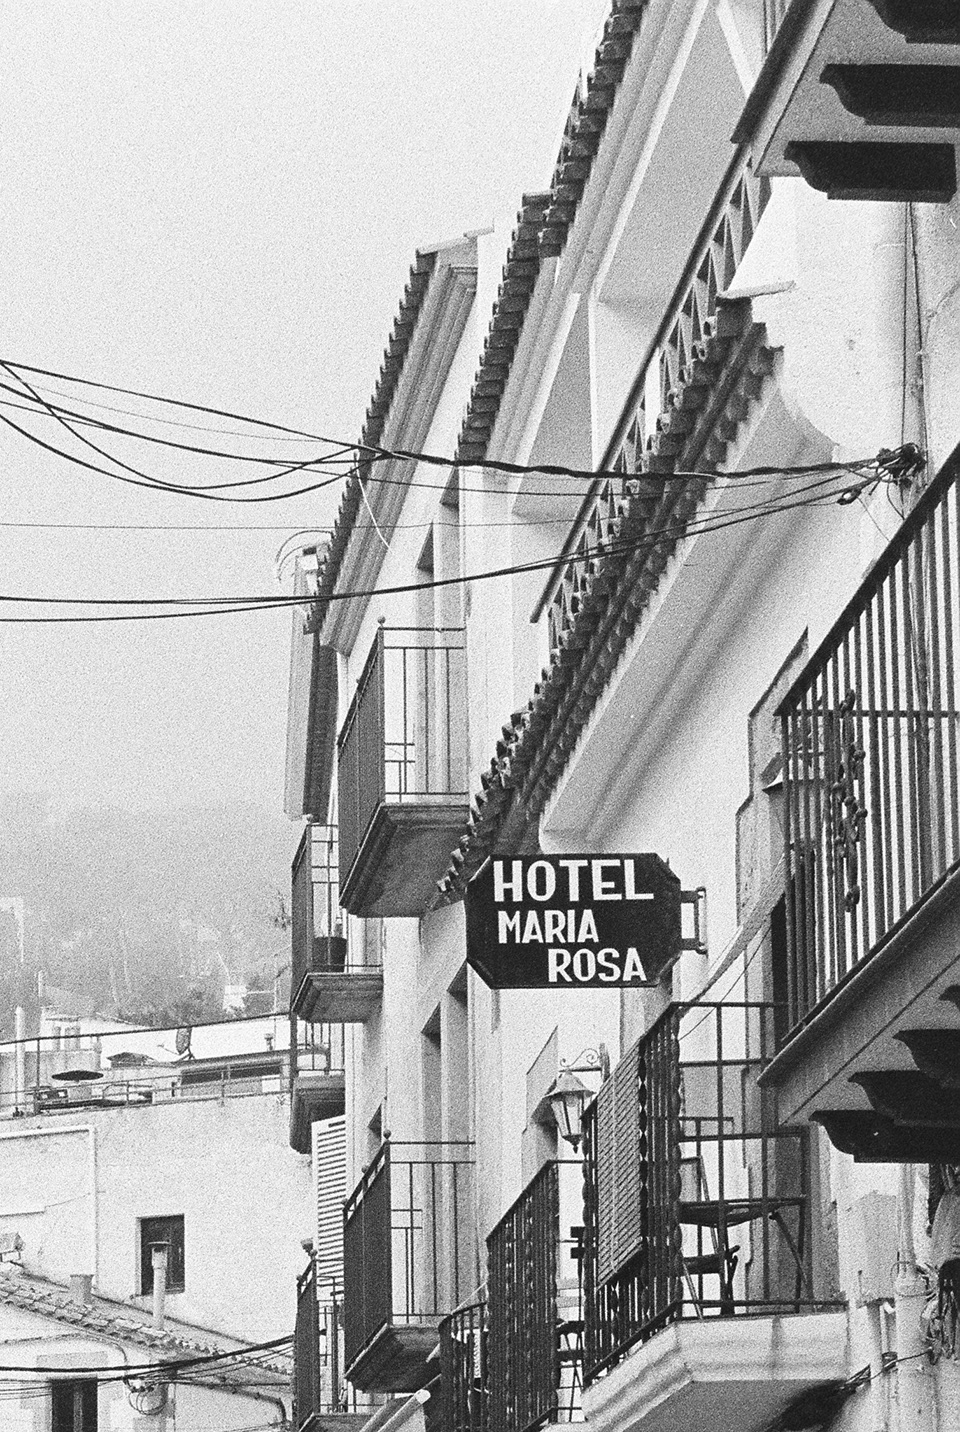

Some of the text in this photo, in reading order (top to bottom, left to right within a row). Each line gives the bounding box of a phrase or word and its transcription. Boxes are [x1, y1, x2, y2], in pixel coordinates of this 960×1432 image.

[493, 859, 655, 902] HOTEL
[498, 909, 599, 944] MARIA
[548, 947, 648, 982] ROSA
